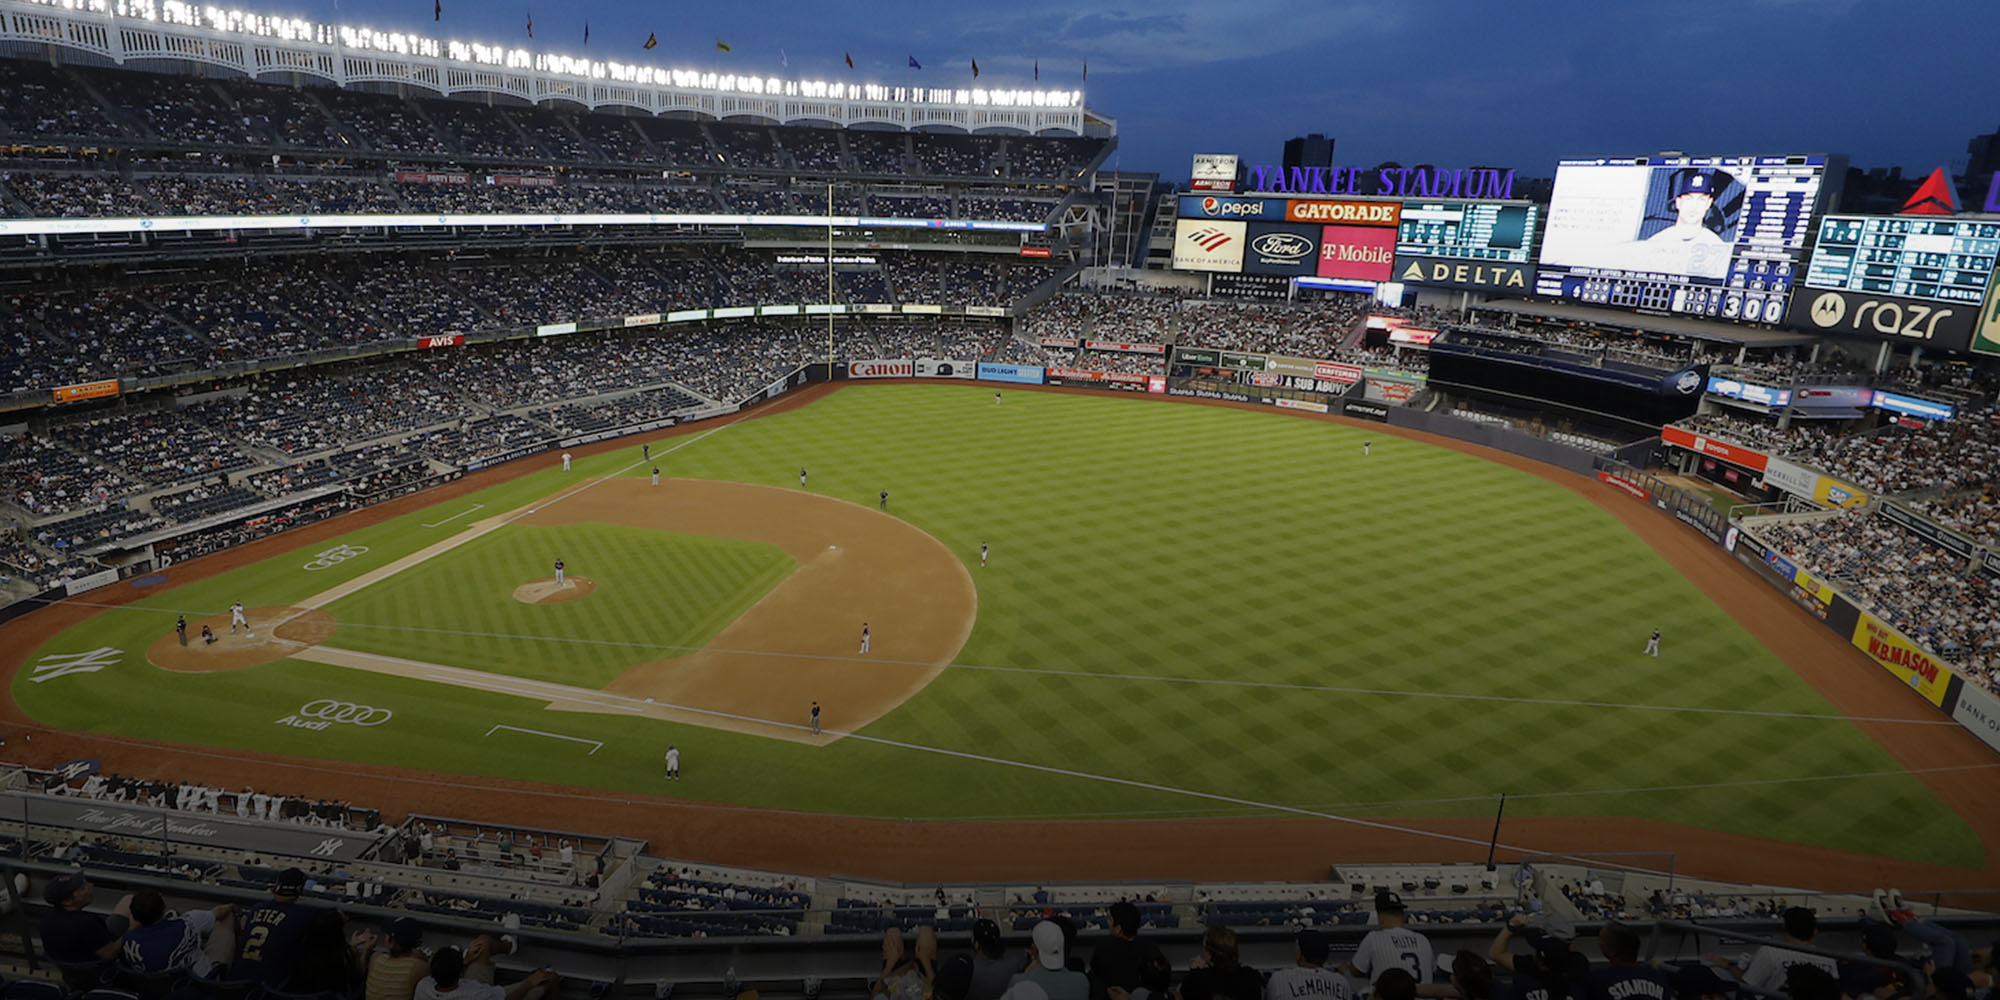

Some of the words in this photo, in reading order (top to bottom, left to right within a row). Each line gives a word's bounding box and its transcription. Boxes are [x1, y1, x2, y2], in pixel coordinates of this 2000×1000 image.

[427, 174, 448, 183] PARTY
[449, 175, 466, 183] DECK
[1255, 165, 1363, 195] YANKEE
[1377, 168, 1516, 200] STADIUM
[1221, 201, 1264, 217] pepsi
[1294, 203, 1395, 222] GATORADE
[1261, 236, 1302, 256] Ford
[1338, 244, 1393, 264] Mobile
[1433, 263, 1524, 287] DELTA
[1949, 290, 1981, 301] DELTA
[1725, 297, 1738, 316] 3
[1744, 299, 1760, 319] 0
[1765, 301, 1780, 321] 0
[1853, 300, 1953, 339] razr
[428, 336, 454, 347] AVIS
[1197, 354, 1212, 362] Eats
[850, 362, 911, 376] Canon
[1317, 367, 1358, 378] CRAFTSMAN
[1285, 376, 1292, 387] A
[1294, 377, 1313, 389] SUB
[1706, 443, 1729, 456] TOYOTA
[1751, 477, 1769, 492] FedEx
[1767, 467, 1797, 485] MERRILL
[1829, 487, 1847, 504] SAP
[1960, 698, 1986, 724] BANK
[274, 714, 333, 731] Audi
[76, 808, 109, 823] New
[104, 811, 149, 834] York
[146, 817, 217, 838] Yankees
[250, 908, 288, 927] JETER
[240, 925, 270, 960] 2
[1391, 935, 1418, 949] RUTH
[1401, 953, 1421, 983] 3
[1608, 978, 1664, 999] STANTON
